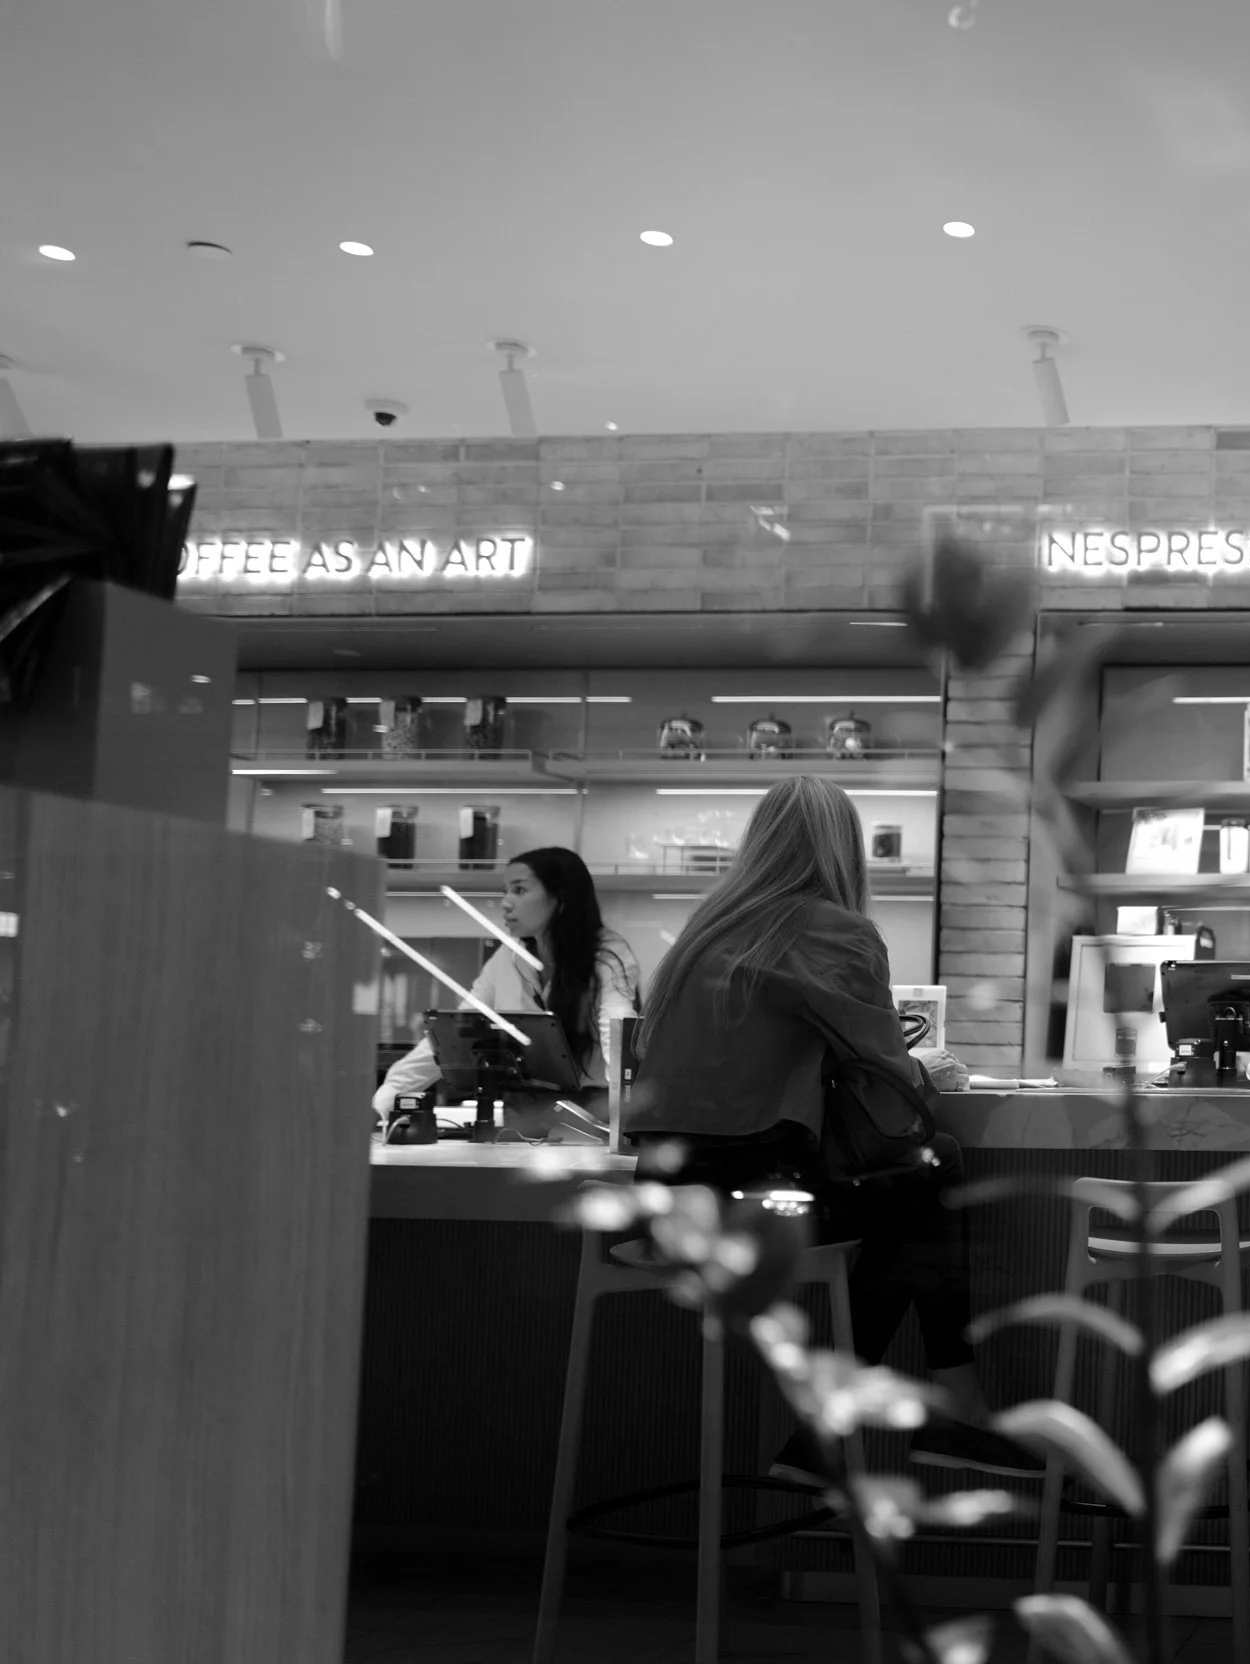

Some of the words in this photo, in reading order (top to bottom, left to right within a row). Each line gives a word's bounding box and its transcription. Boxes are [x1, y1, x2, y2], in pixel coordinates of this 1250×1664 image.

[305, 540, 354, 573] AS
[367, 540, 427, 572] AN
[441, 538, 526, 571] ART
